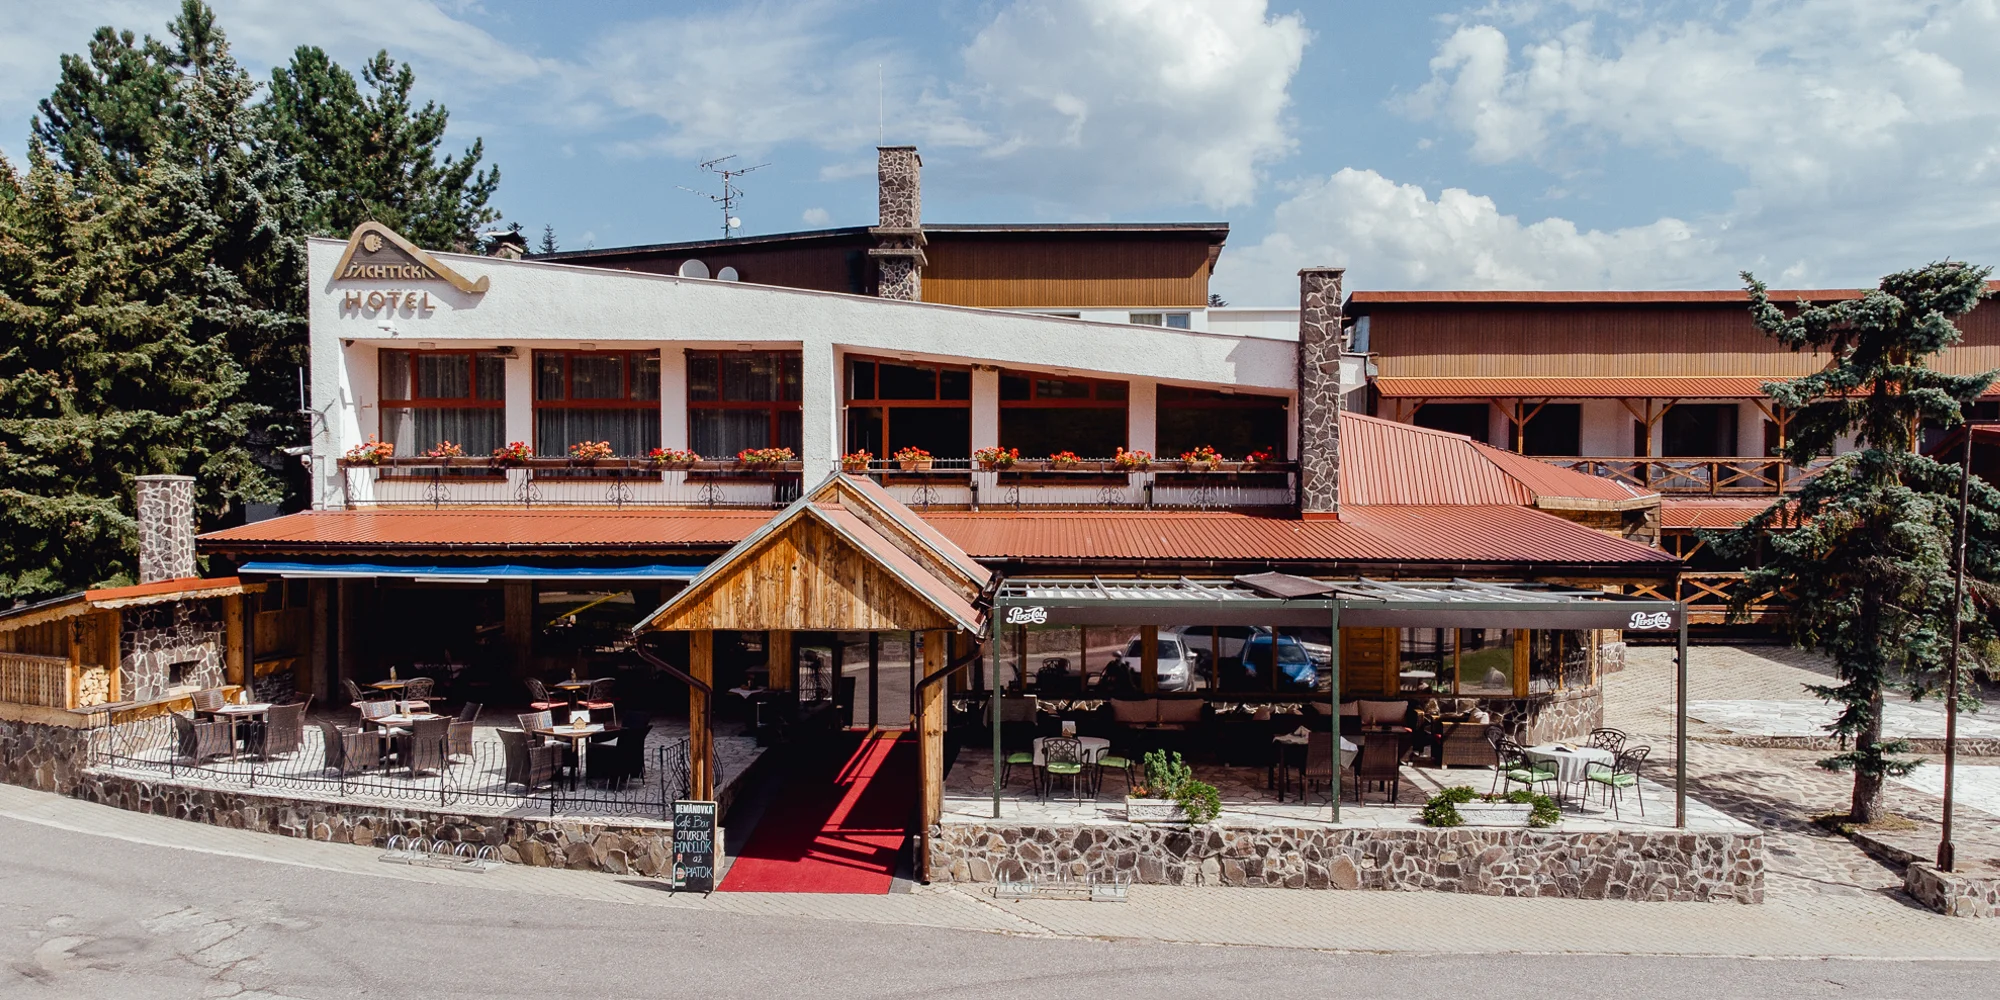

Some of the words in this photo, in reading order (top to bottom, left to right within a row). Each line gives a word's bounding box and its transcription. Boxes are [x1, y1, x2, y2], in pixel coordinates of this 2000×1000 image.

[345, 291, 436, 310] HOTEL
[675, 814, 691, 830] Café
[692, 815, 710, 828] Bar
[676, 829, 710, 841] OTVORENÉ
[685, 866, 713, 878] PIATOK
